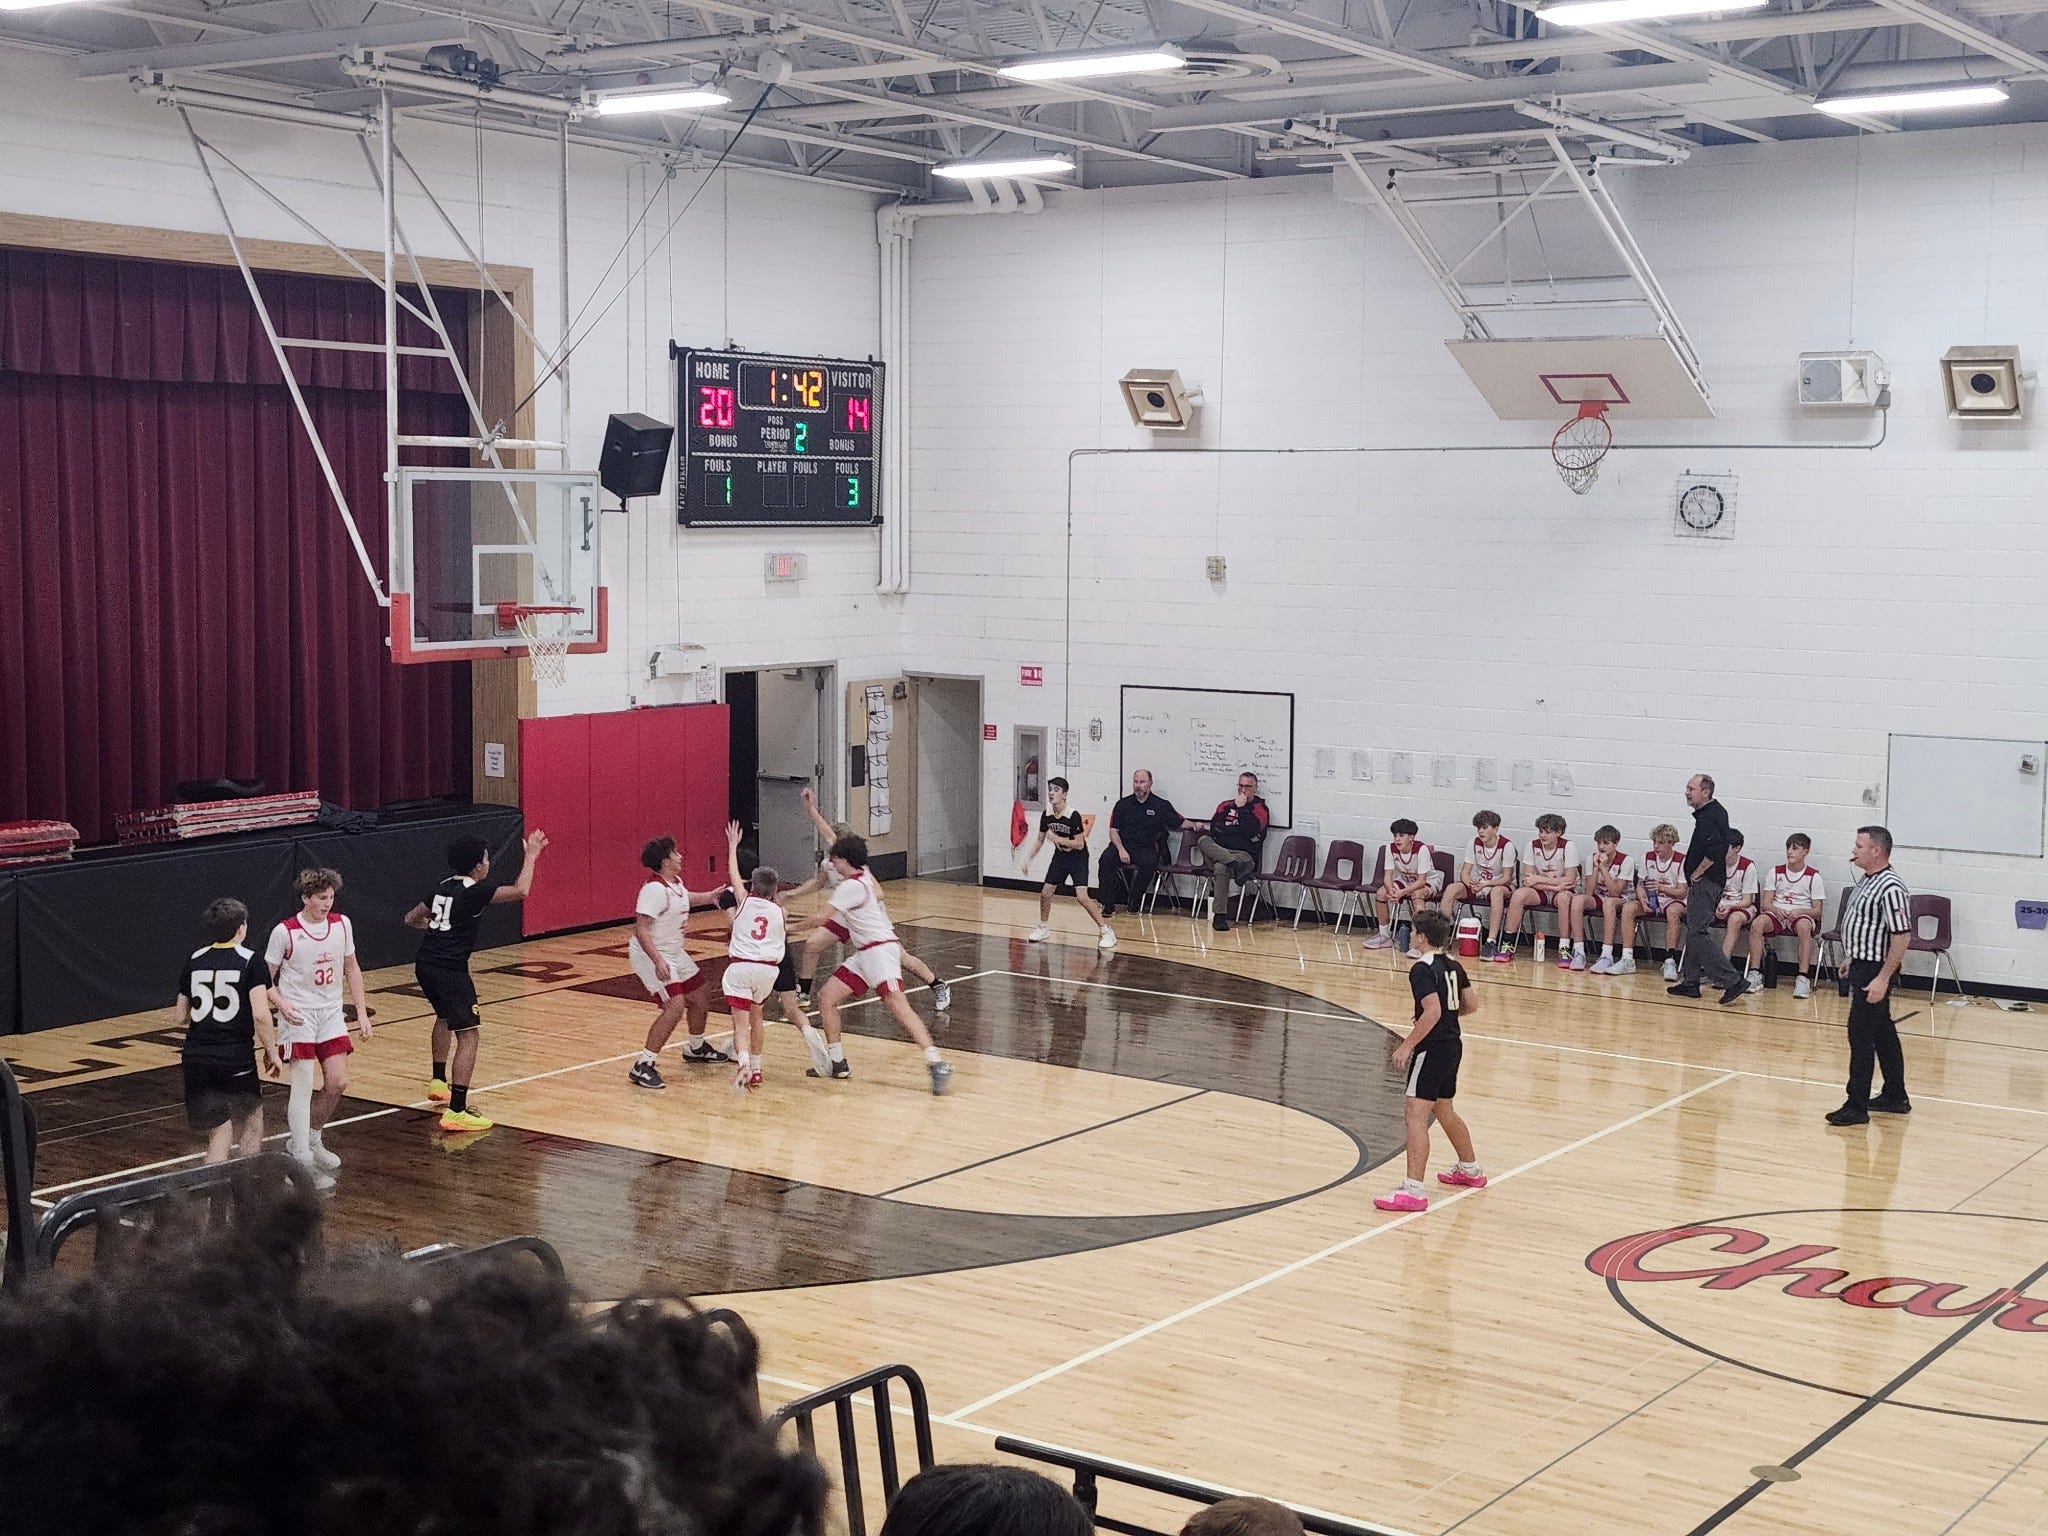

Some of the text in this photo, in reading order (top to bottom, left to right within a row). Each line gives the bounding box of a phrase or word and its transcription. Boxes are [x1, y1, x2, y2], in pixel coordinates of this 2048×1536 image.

[695, 361, 730, 380] HOME
[831, 371, 872, 389] VISITOR
[771, 369, 823, 407] 1:42
[701, 387, 734, 427] 20
[847, 397, 870, 432] 14
[767, 415, 784, 426] POSS
[709, 434, 738, 448] BONUS
[760, 427, 791, 441] PERIOD
[796, 422, 807, 452] 2
[829, 438, 855, 452] BONUS
[704, 459, 732, 472] FOULS
[757, 461, 818, 474] PLAYER FOULS
[835, 462, 859, 475] FOULS
[725, 476, 731, 504] 1
[848, 477, 859, 507] 3
[751, 916, 768, 941] 3
[314, 966, 334, 986] 32
[190, 969, 241, 1023] 55
